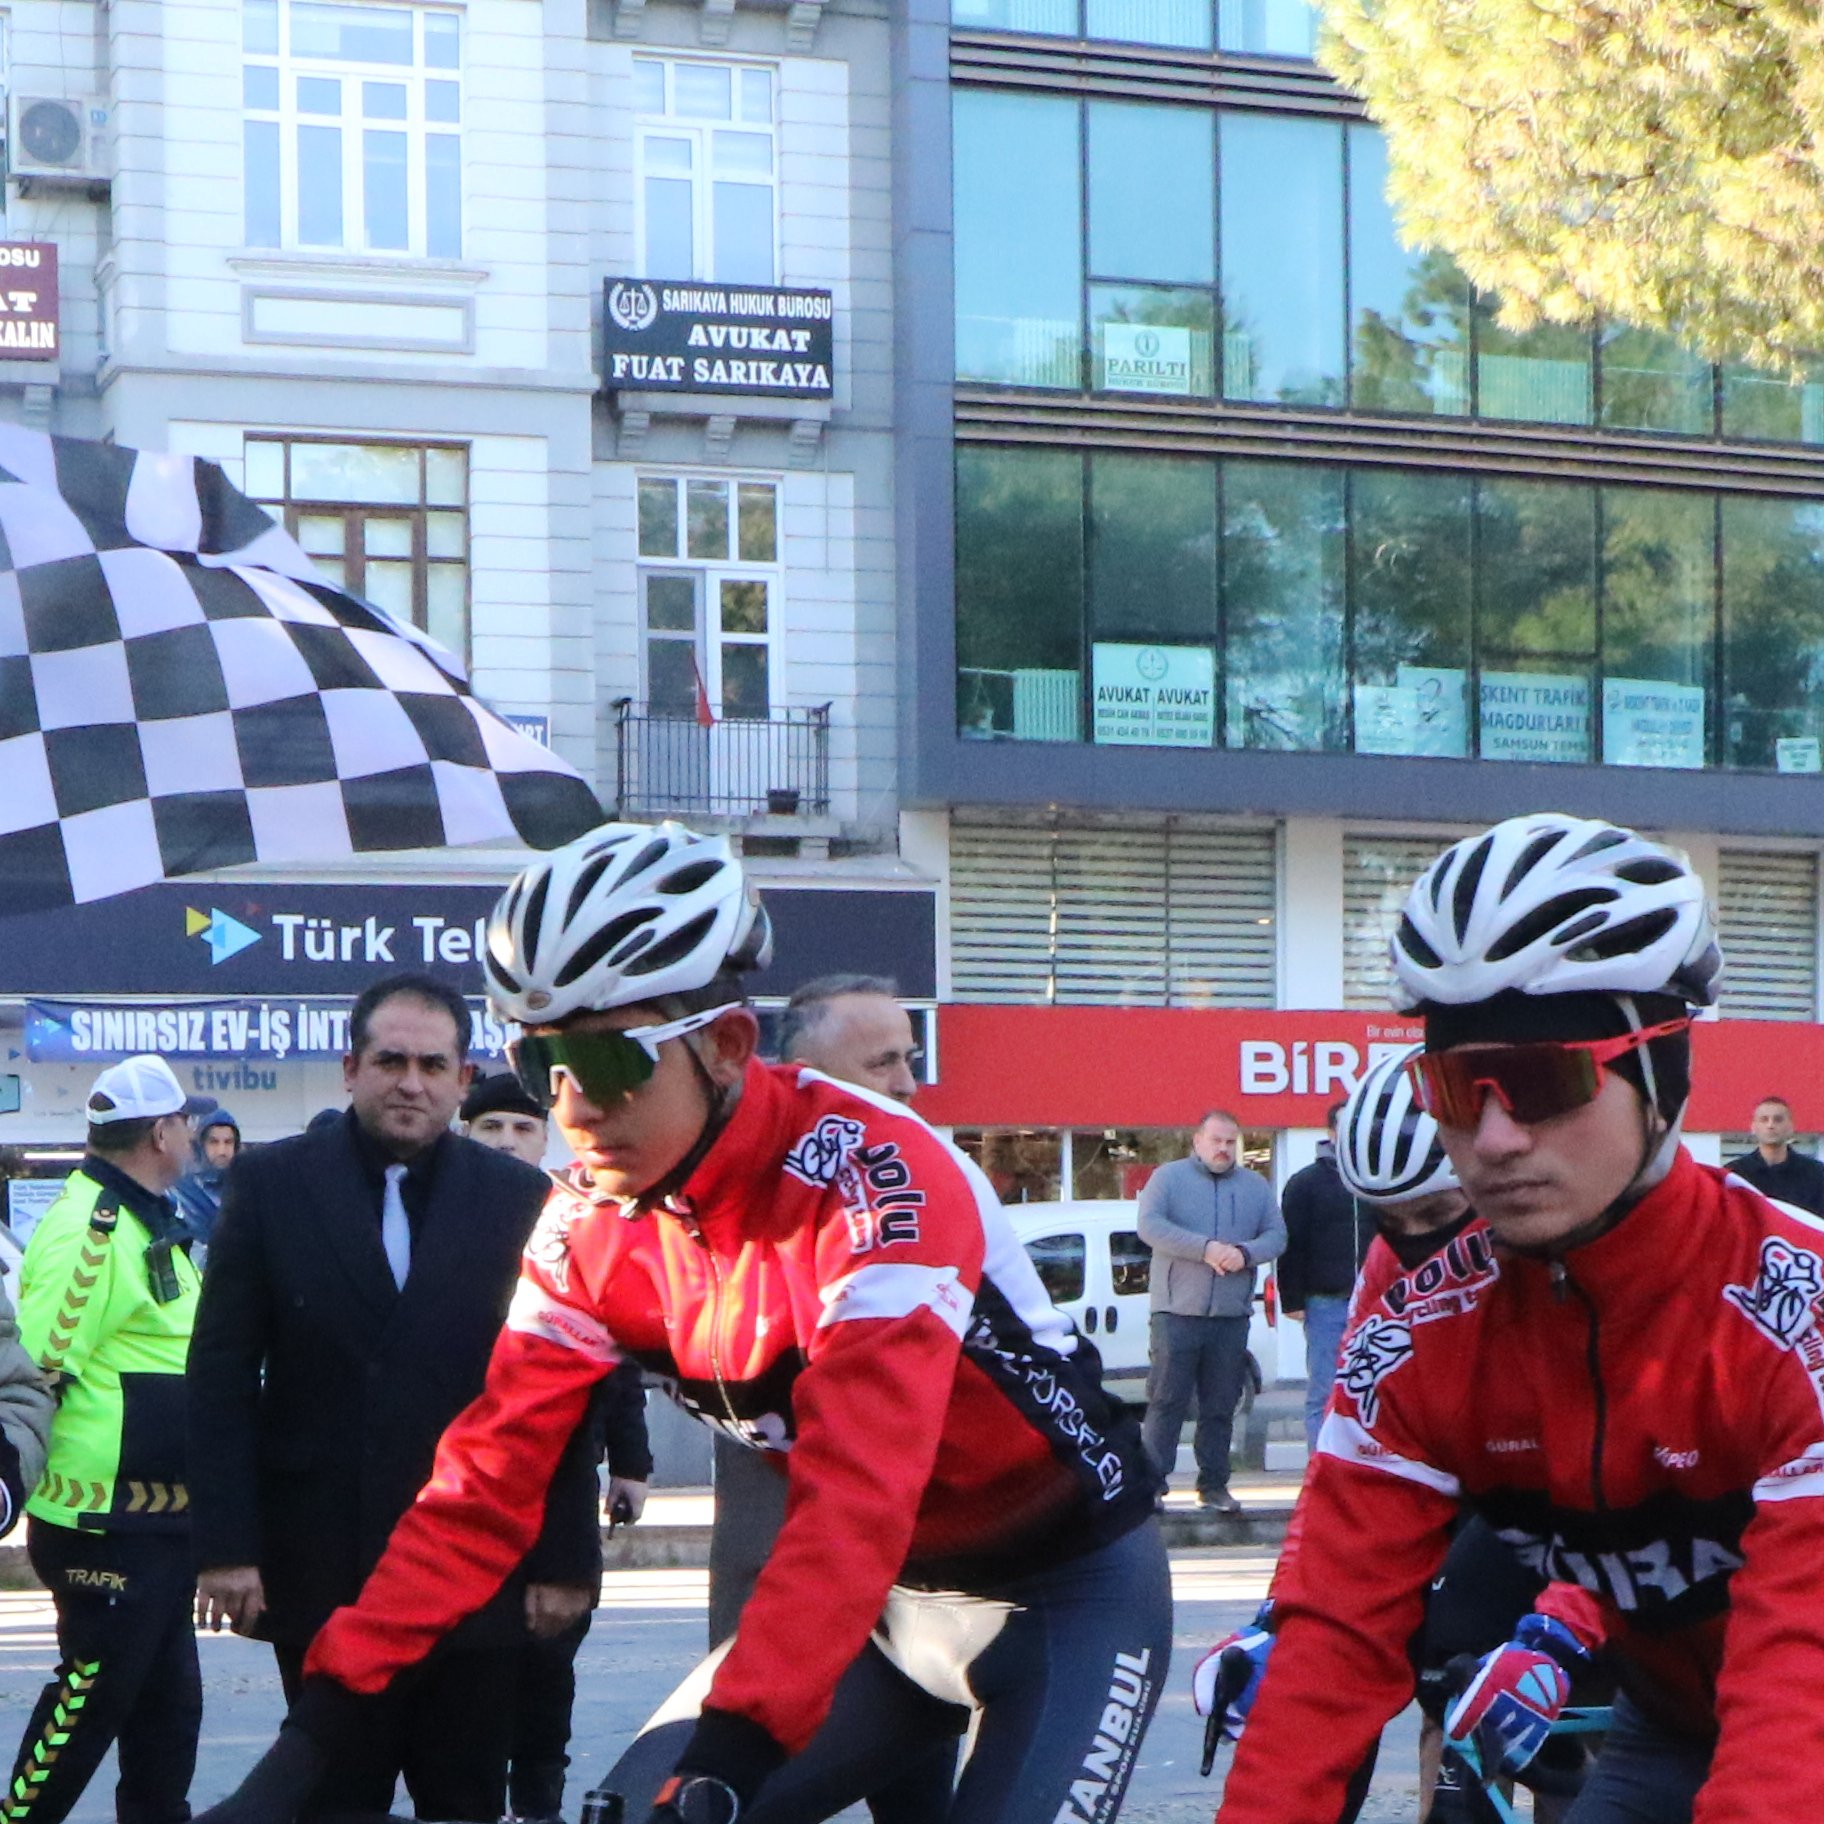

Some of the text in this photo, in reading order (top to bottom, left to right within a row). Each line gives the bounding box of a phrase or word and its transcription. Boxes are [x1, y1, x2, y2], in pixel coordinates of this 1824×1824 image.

[663, 289, 726, 314] SARIKAYA
[730, 293, 775, 316] HUKUK
[688, 324, 811, 353] AVUKAT
[612, 354, 830, 389] FUAT SARIKAYA
[1098, 687, 1150, 703] AVUKAT
[1157, 688, 1209, 705] AVUKAT
[273, 914, 396, 963] Türk
[71, 1011, 205, 1052] SINIRSIZ
[212, 1005, 290, 1059] EV-İŞ
[194, 1059, 276, 1091] tivibu
